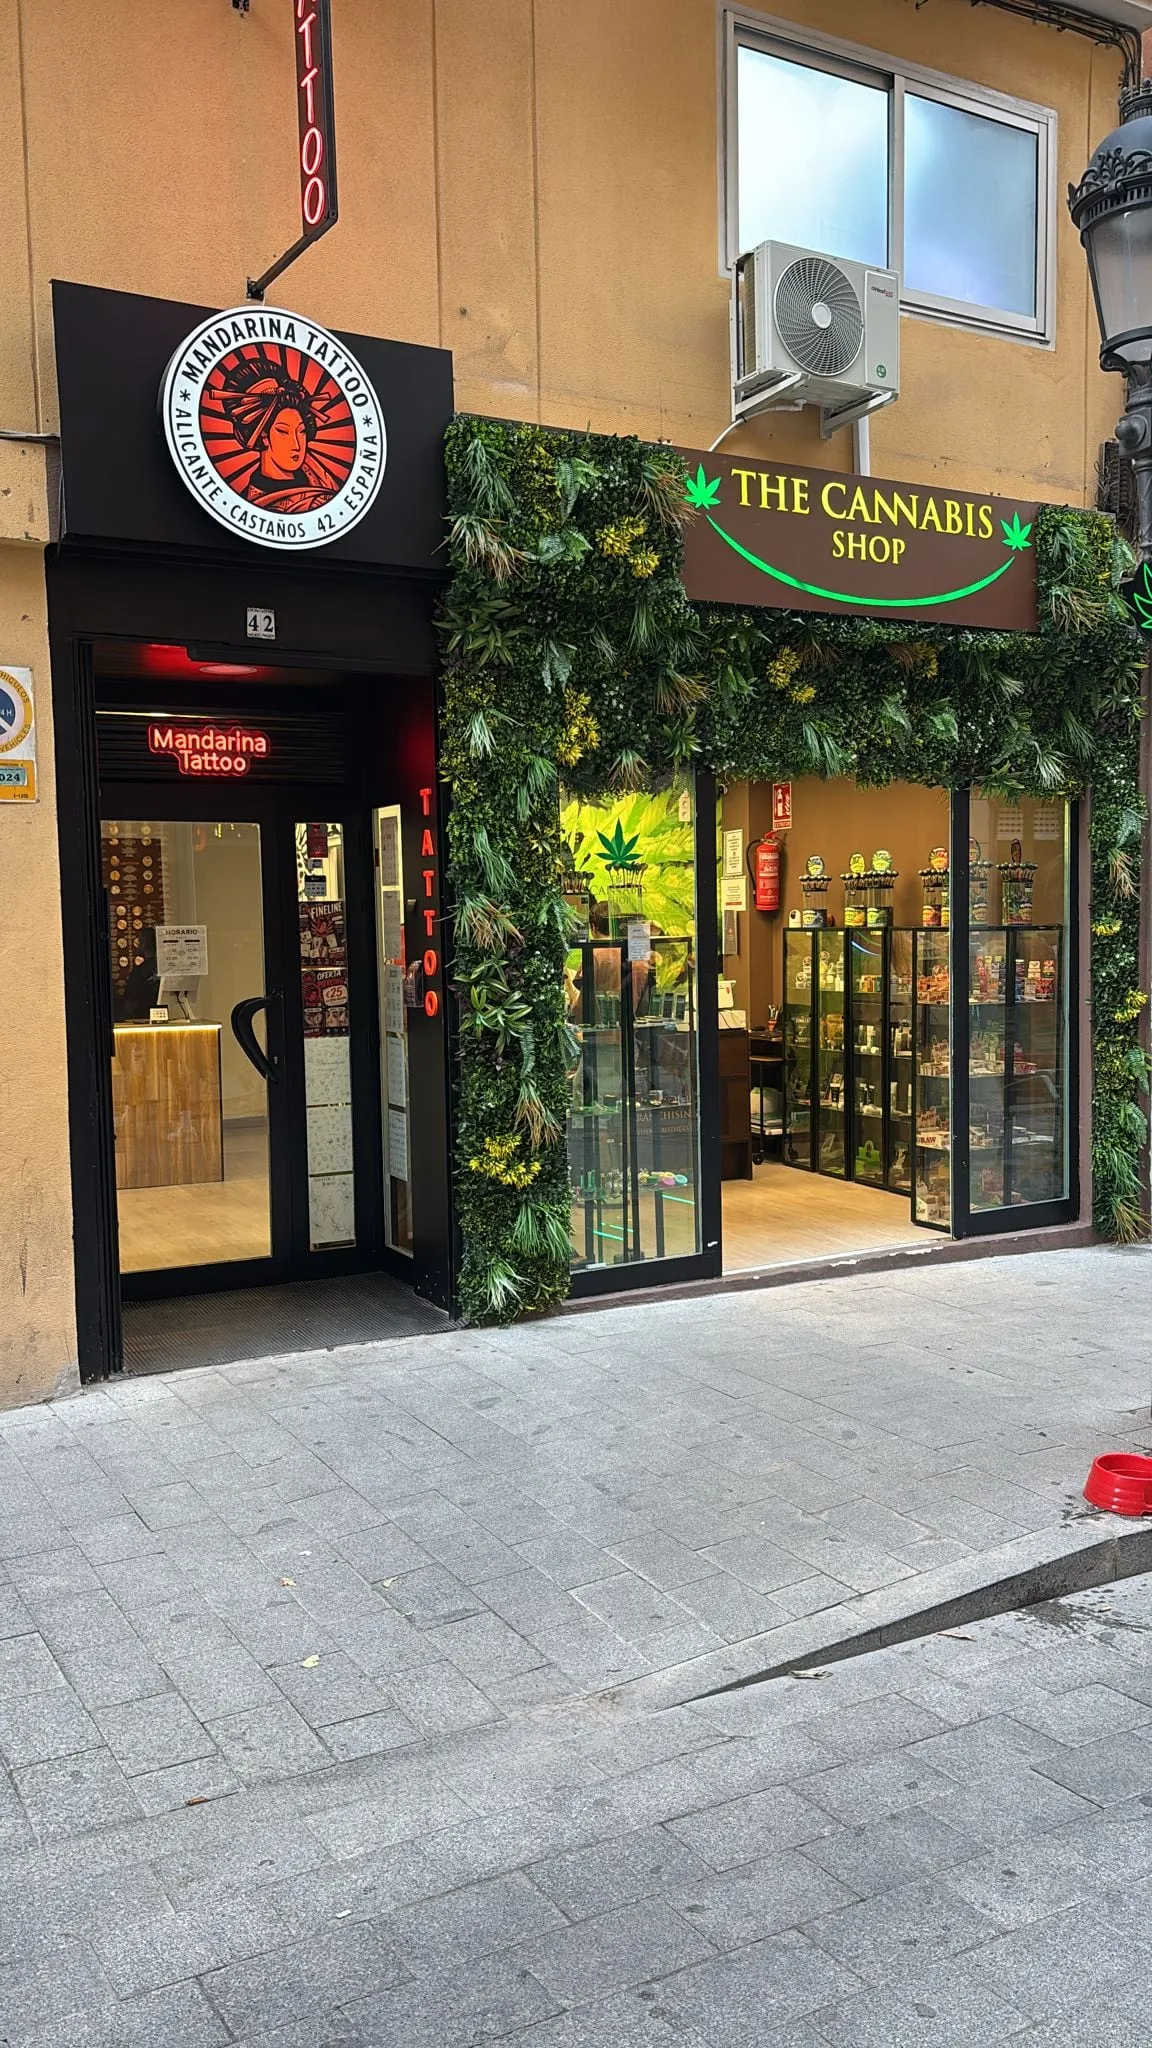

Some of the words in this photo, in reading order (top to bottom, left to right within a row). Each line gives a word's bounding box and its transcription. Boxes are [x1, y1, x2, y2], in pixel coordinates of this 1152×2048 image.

[297, 0, 325, 226] TTOO
[181, 316, 297, 385] MANDARINA
[305, 330, 370, 409] TATTOO
[175, 407, 224, 503] ALICANTE
[229, 504, 307, 540] CASTAÑOS
[317, 512, 336, 533] 42
[344, 434, 379, 511] ESPAÑA
[730, 467, 811, 516] THE
[820, 481, 994, 540] CANNABIS
[831, 530, 906, 565] SHOP
[248, 614, 274, 633] 42
[153, 728, 267, 753] Mandarina
[179, 749, 246, 772] Tattoo
[311, 901, 343, 919] FINELINE
[419, 788, 438, 1017] TATTOO
[920, 1136, 937, 1144] RAW
